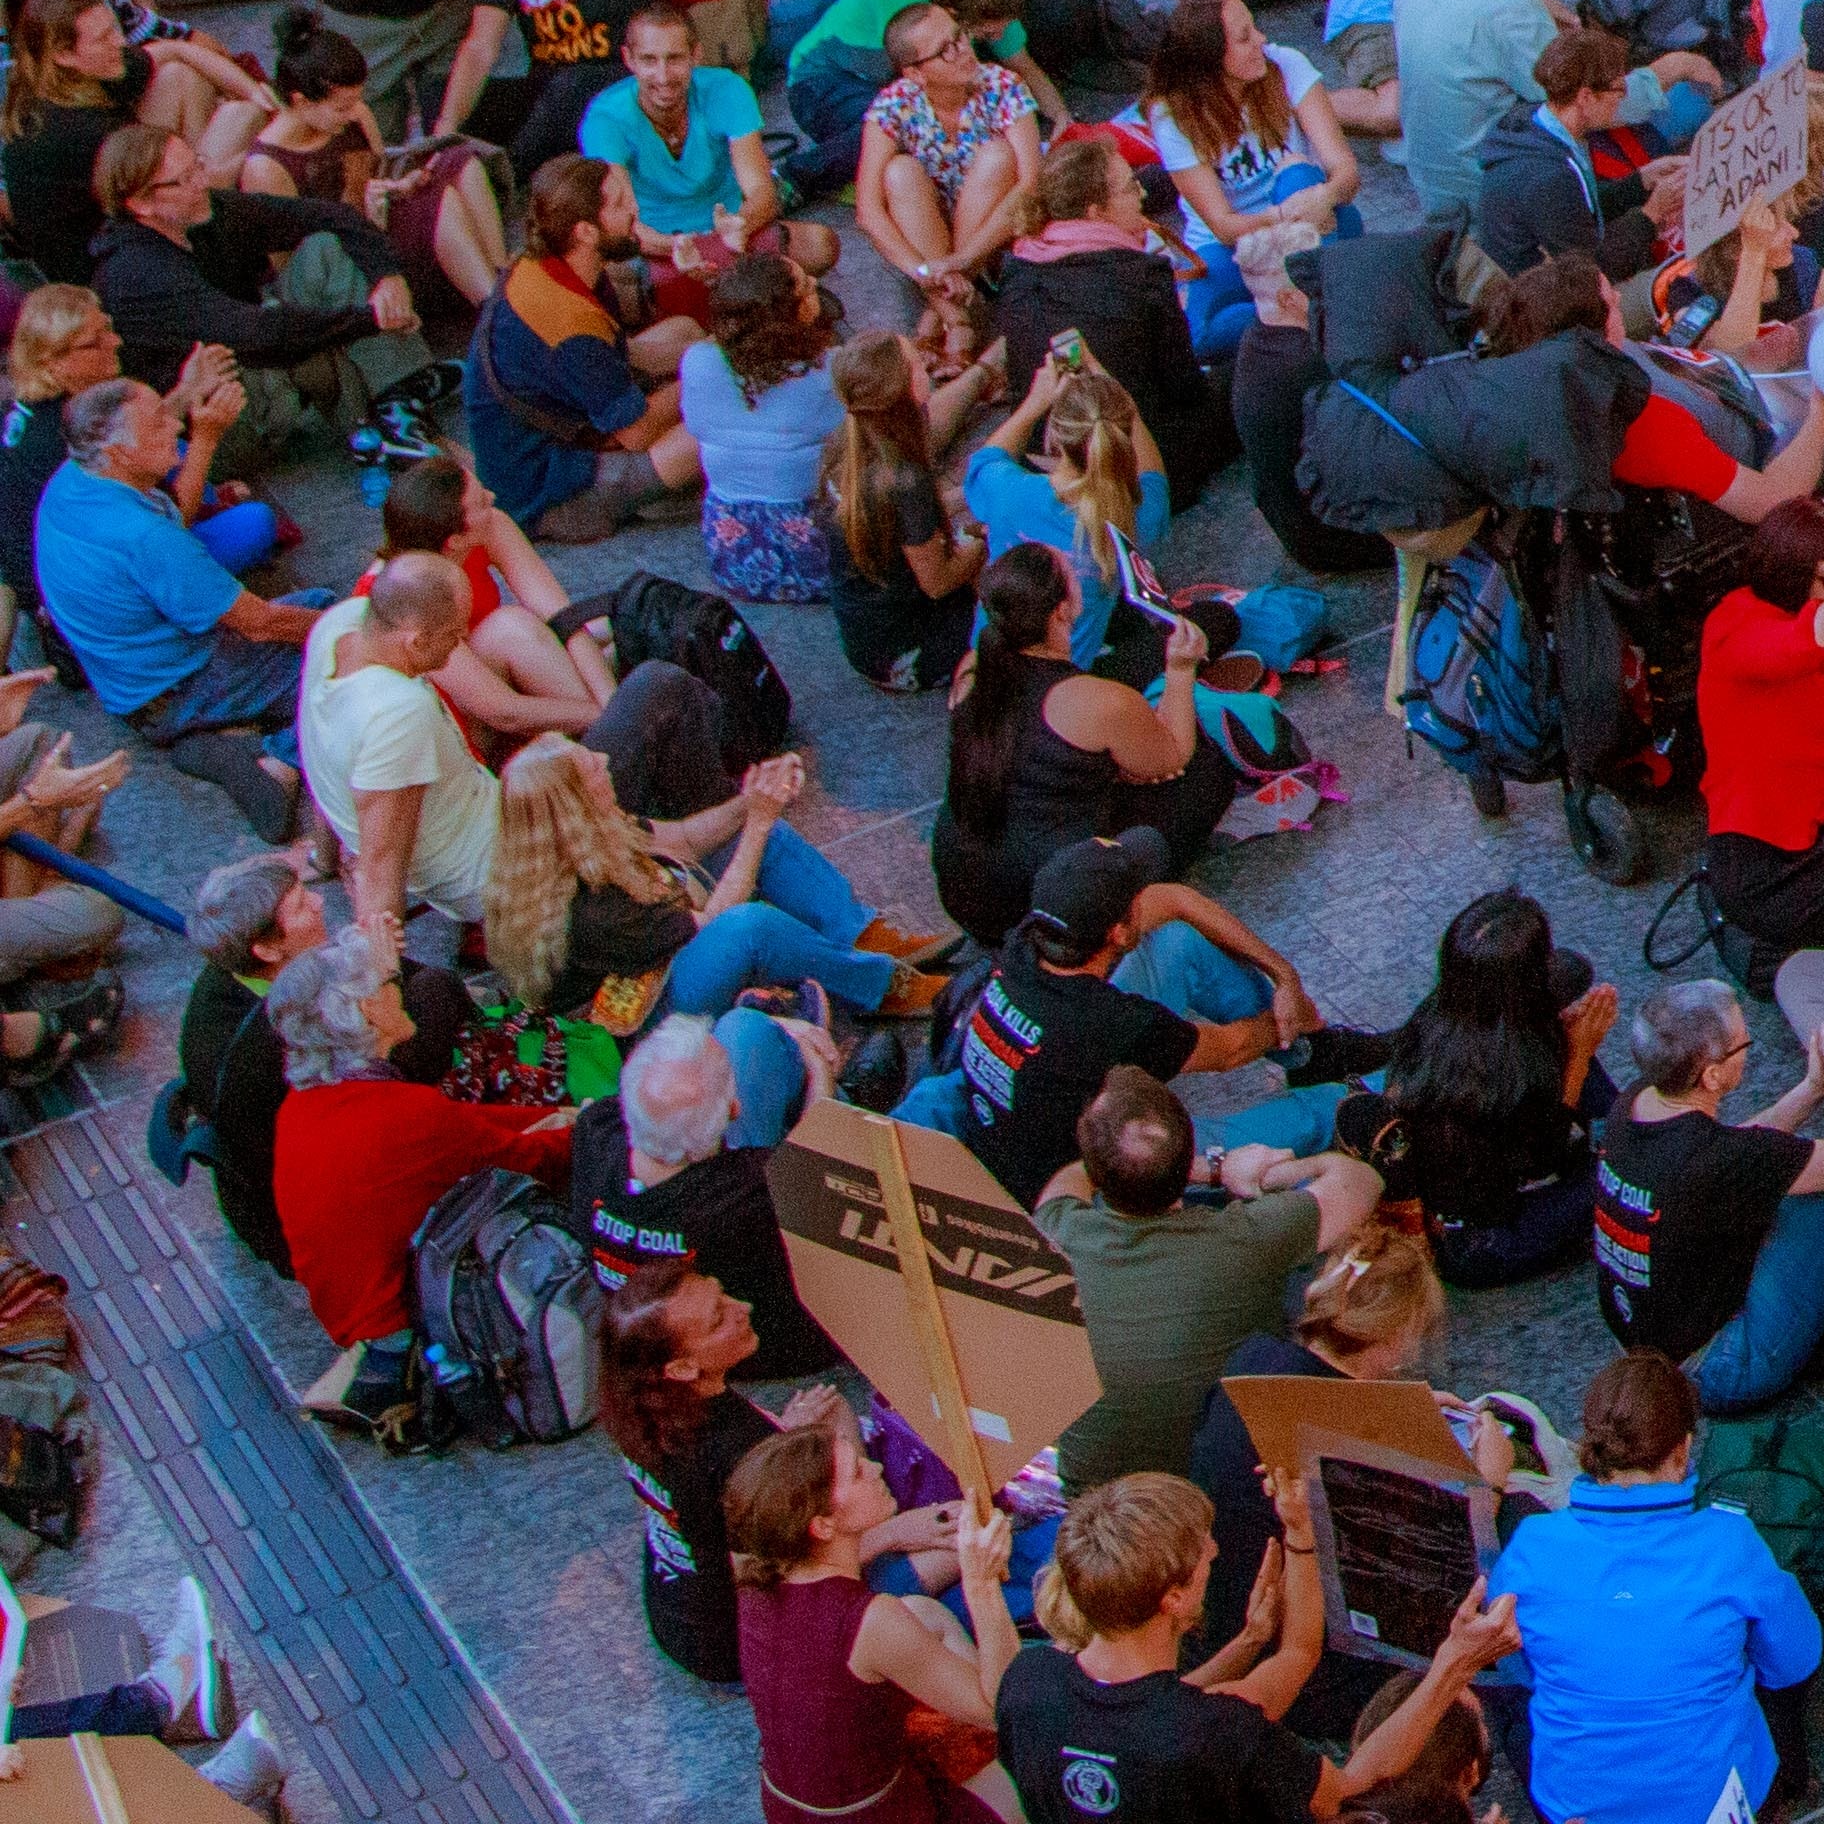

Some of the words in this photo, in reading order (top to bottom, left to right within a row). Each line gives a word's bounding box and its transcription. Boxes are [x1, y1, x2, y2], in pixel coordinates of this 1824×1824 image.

[1743, 125, 1777, 169] NO
[1001, 999, 1042, 1047] KILLS
[1619, 1181, 1654, 1214] COAL
[594, 1209, 636, 1244] STOP
[636, 1227, 688, 1255] COAL
